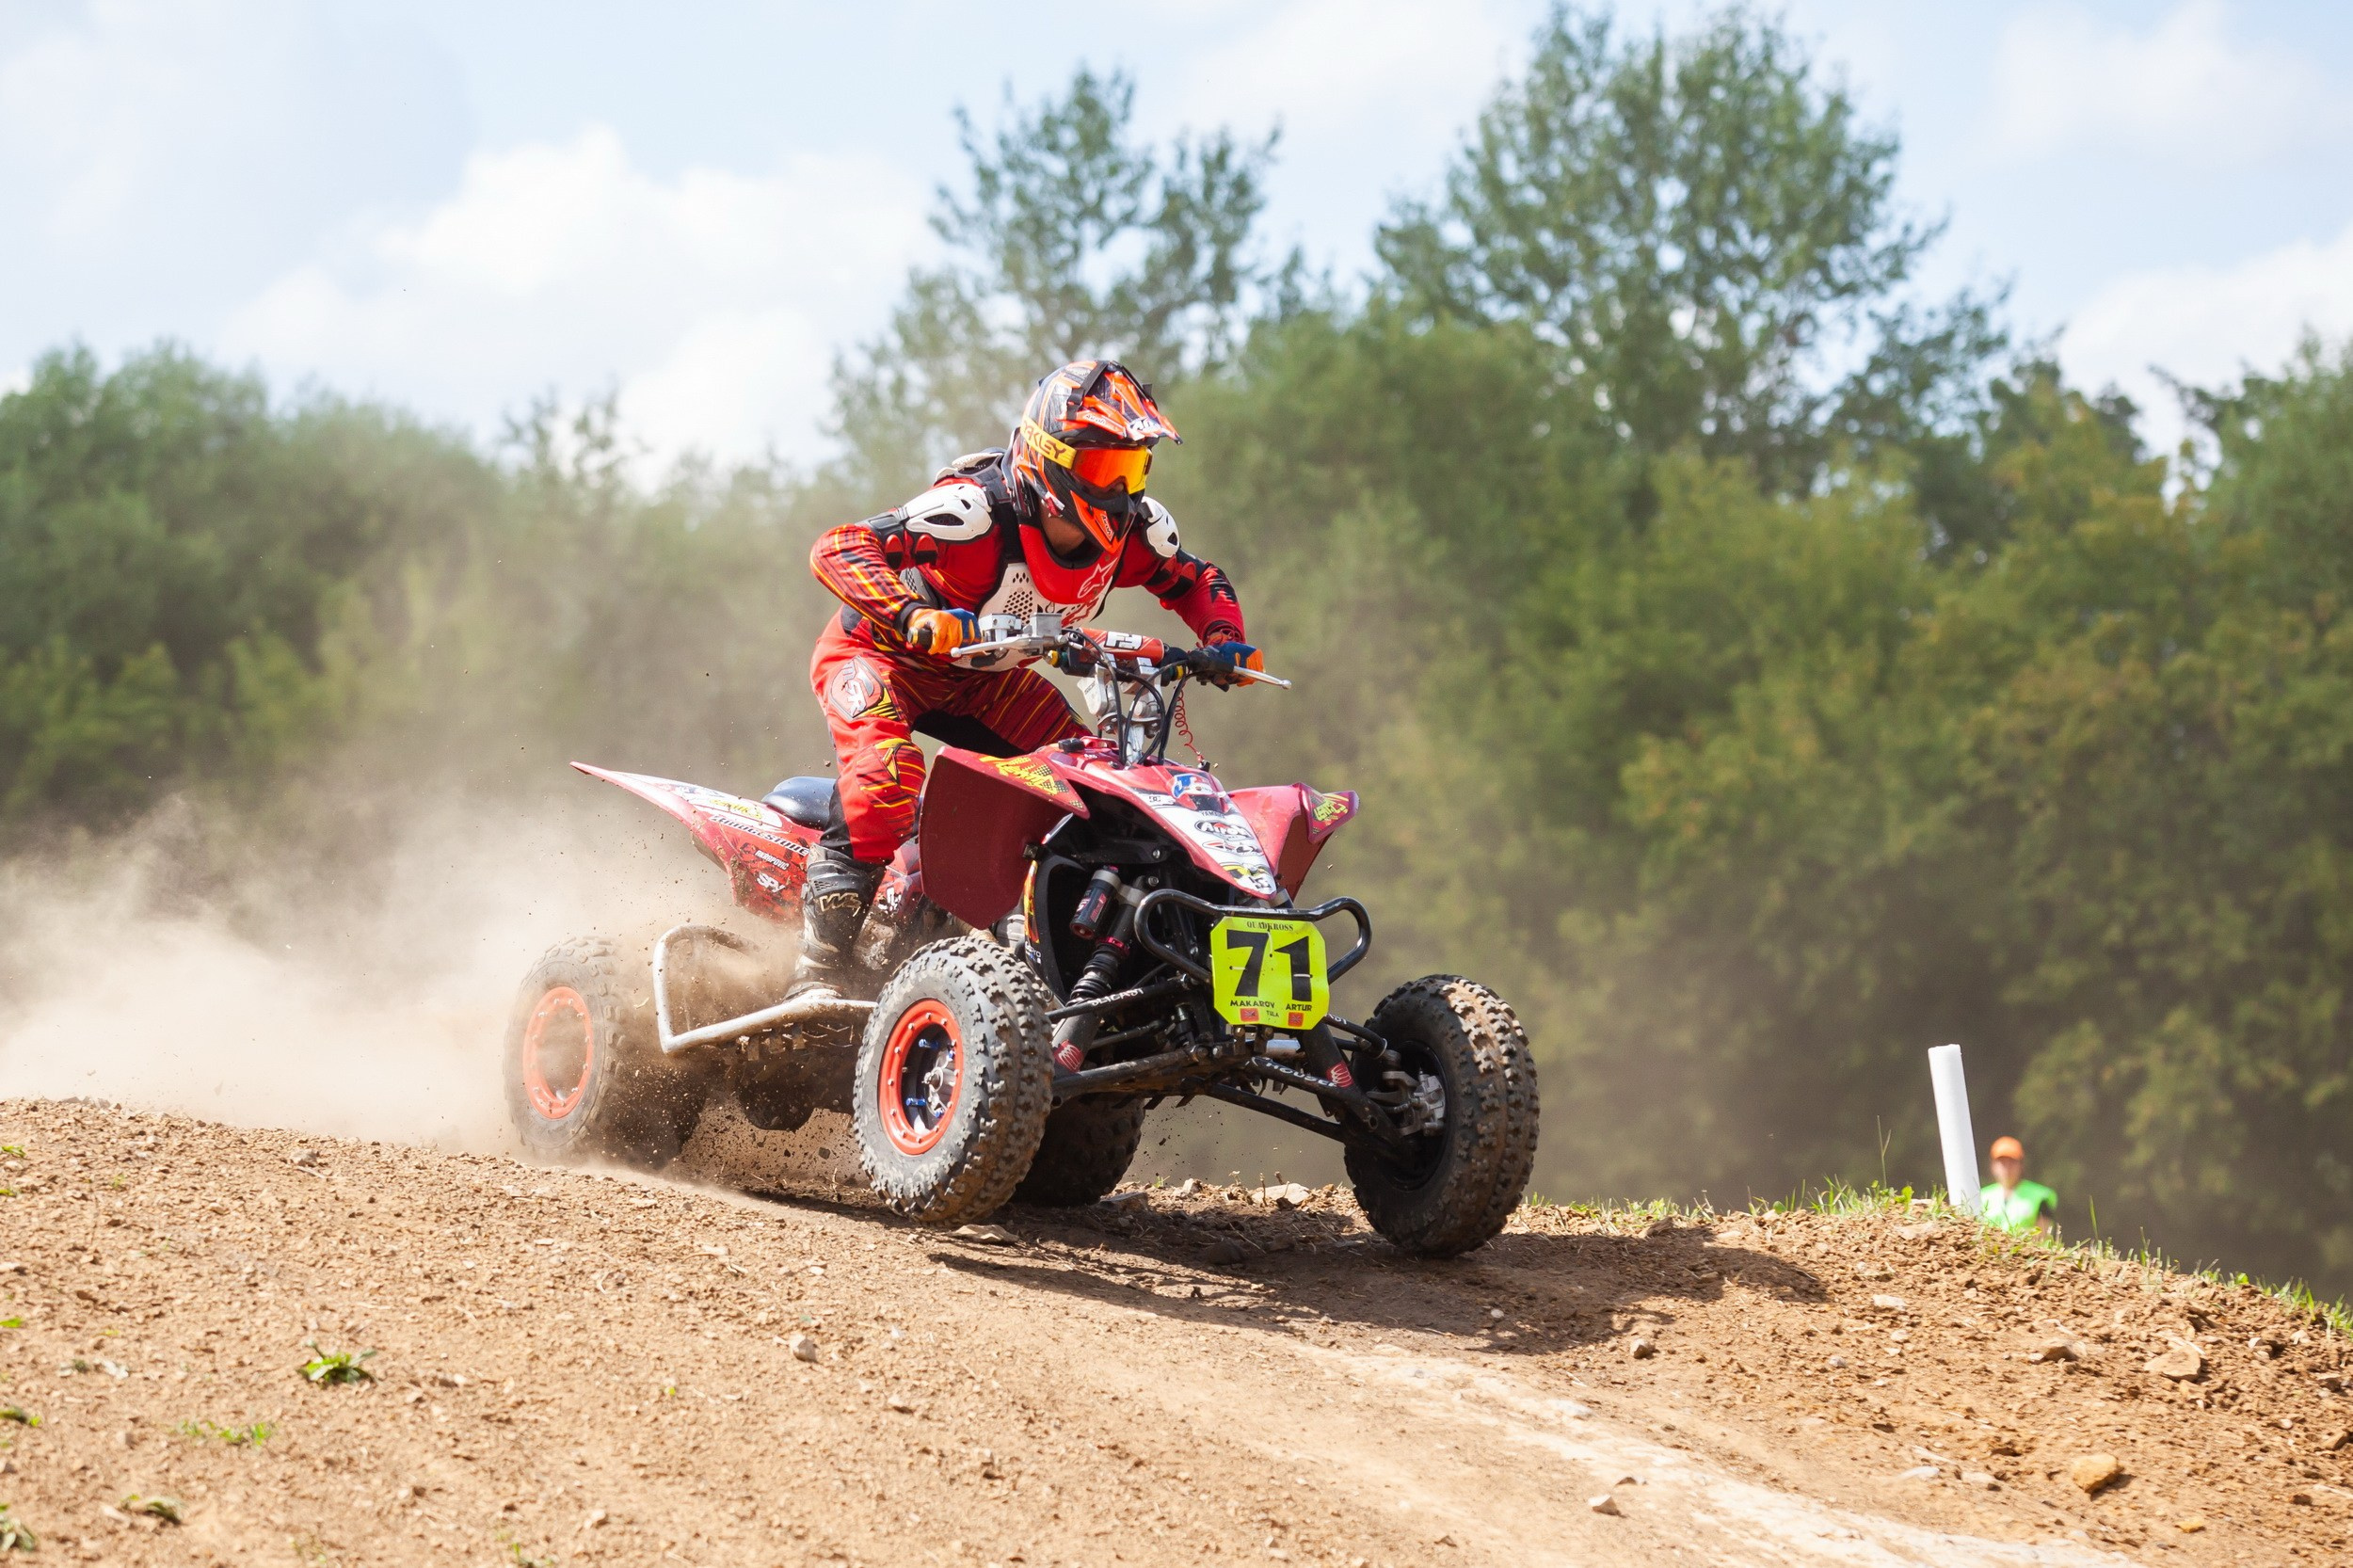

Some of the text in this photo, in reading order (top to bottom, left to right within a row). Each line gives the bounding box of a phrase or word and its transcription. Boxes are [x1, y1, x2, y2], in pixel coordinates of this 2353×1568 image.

[756, 872, 786, 893] SPY
[1226, 929, 1313, 1001] 71
[1229, 1000, 1313, 1012] MAKAROV ARTUR
